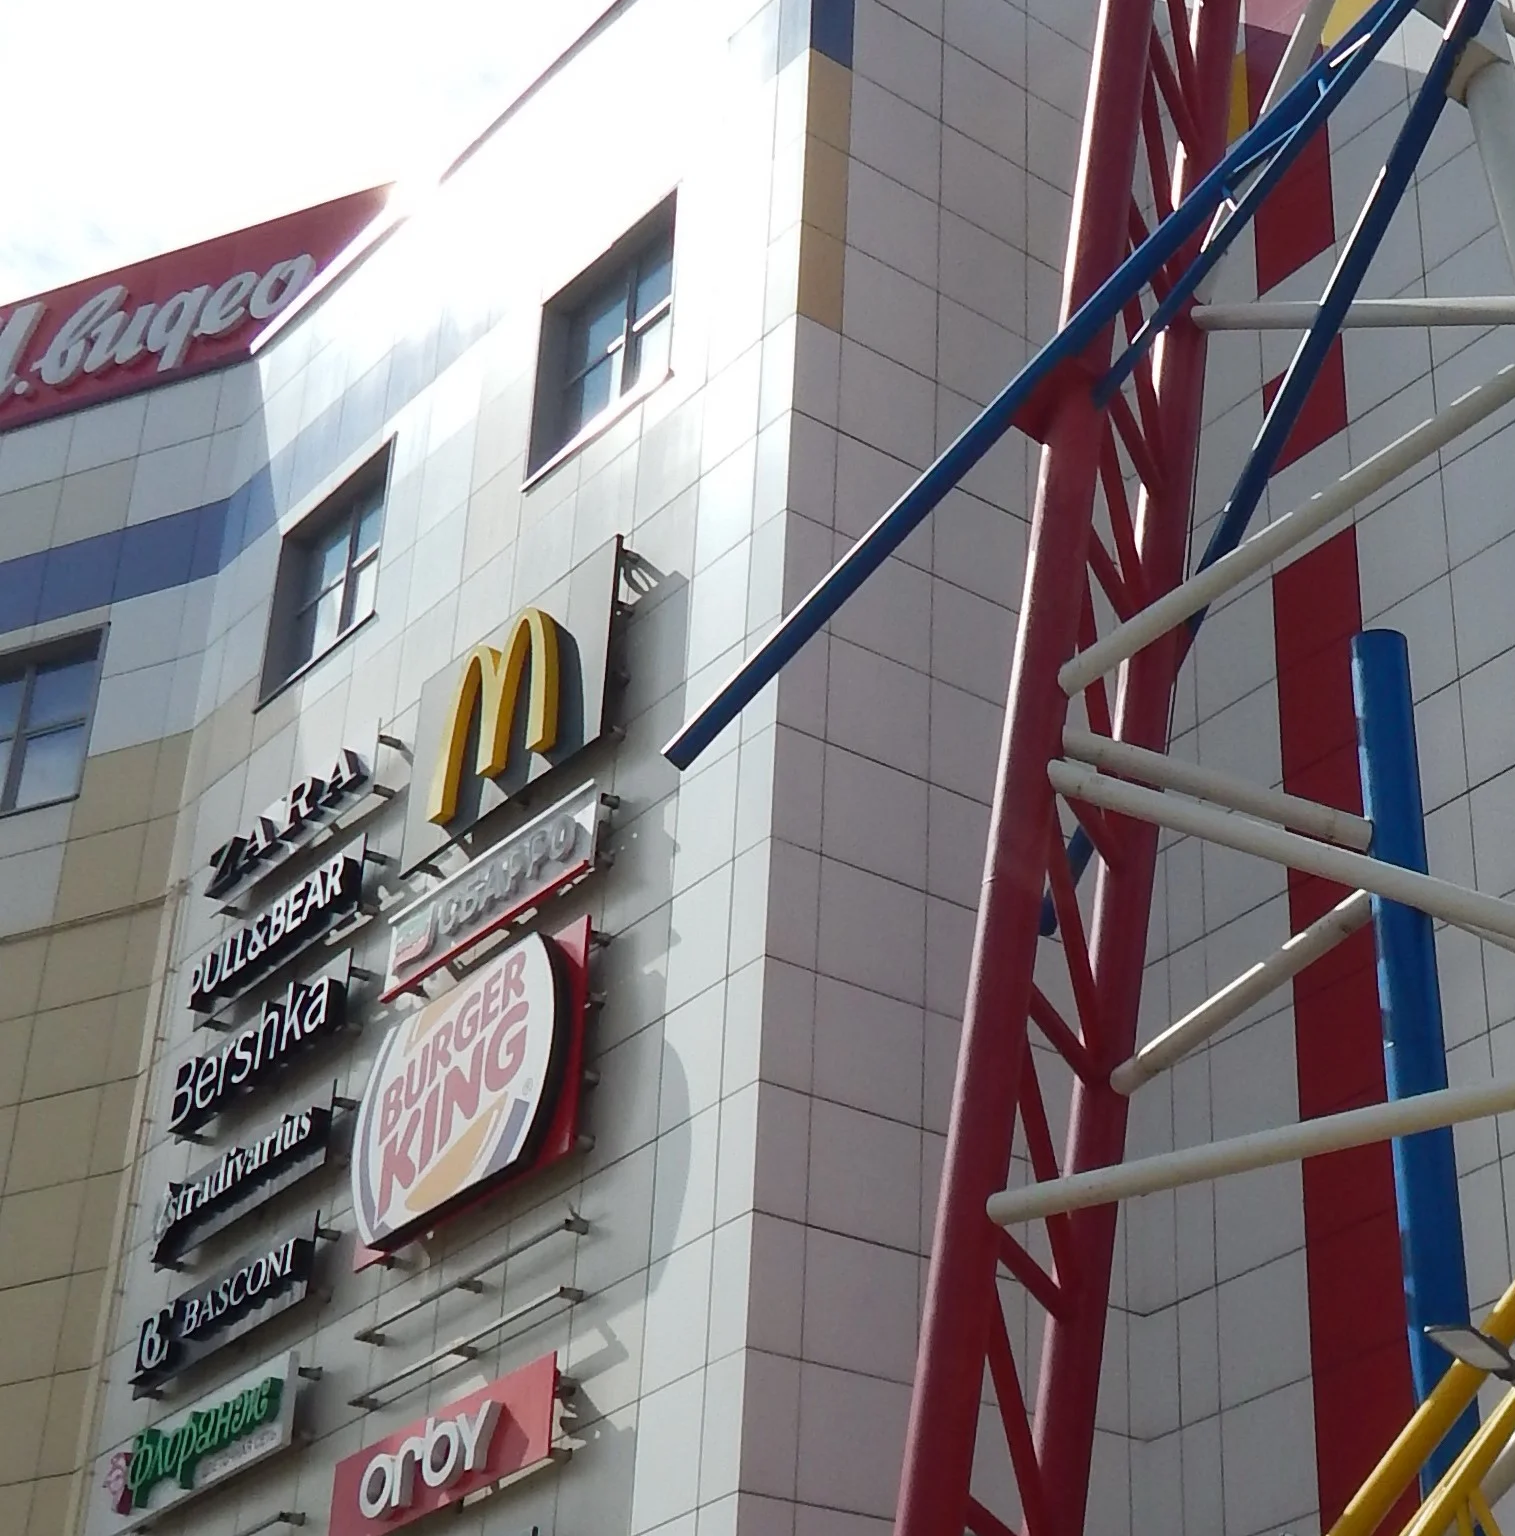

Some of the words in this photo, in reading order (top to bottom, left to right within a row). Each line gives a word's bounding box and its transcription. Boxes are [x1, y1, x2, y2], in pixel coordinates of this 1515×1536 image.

[205, 748, 370, 898] ZARA
[187, 854, 345, 1009] PULL&BEAR
[168, 975, 331, 1132] Bershka
[377, 1001, 530, 1219] KING
[378, 950, 528, 1146] BURGER
[180, 1237, 297, 1338] BASCONI
[359, 1400, 503, 1520] orby
